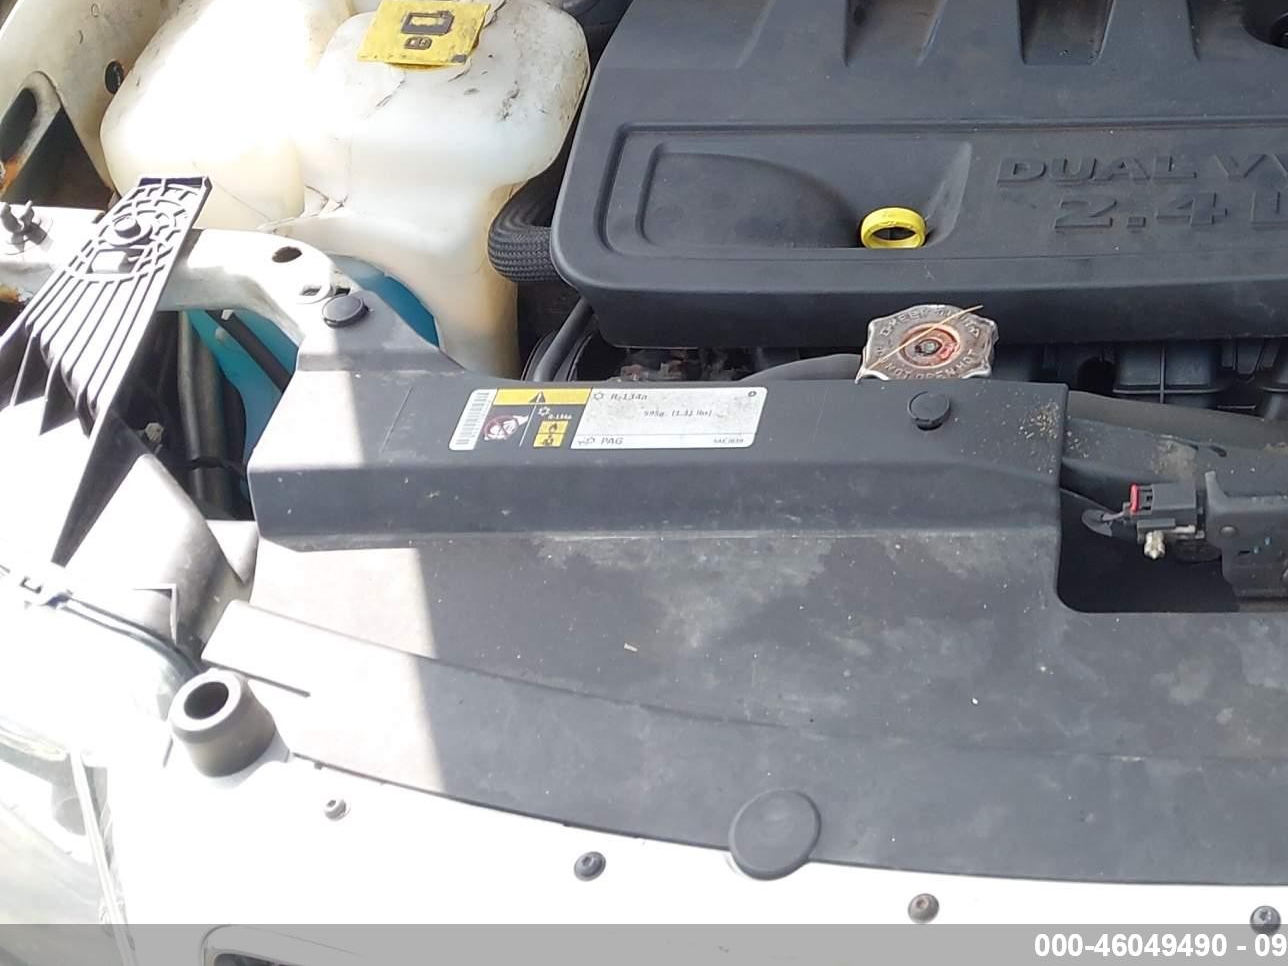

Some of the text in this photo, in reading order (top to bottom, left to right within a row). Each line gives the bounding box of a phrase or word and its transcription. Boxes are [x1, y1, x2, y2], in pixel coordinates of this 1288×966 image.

[997, 154, 1198, 185] DUAL
[885, 362, 912, 379] NOT
[956, 349, 976, 371] HOT
[601, 437, 624, 445] PAG
